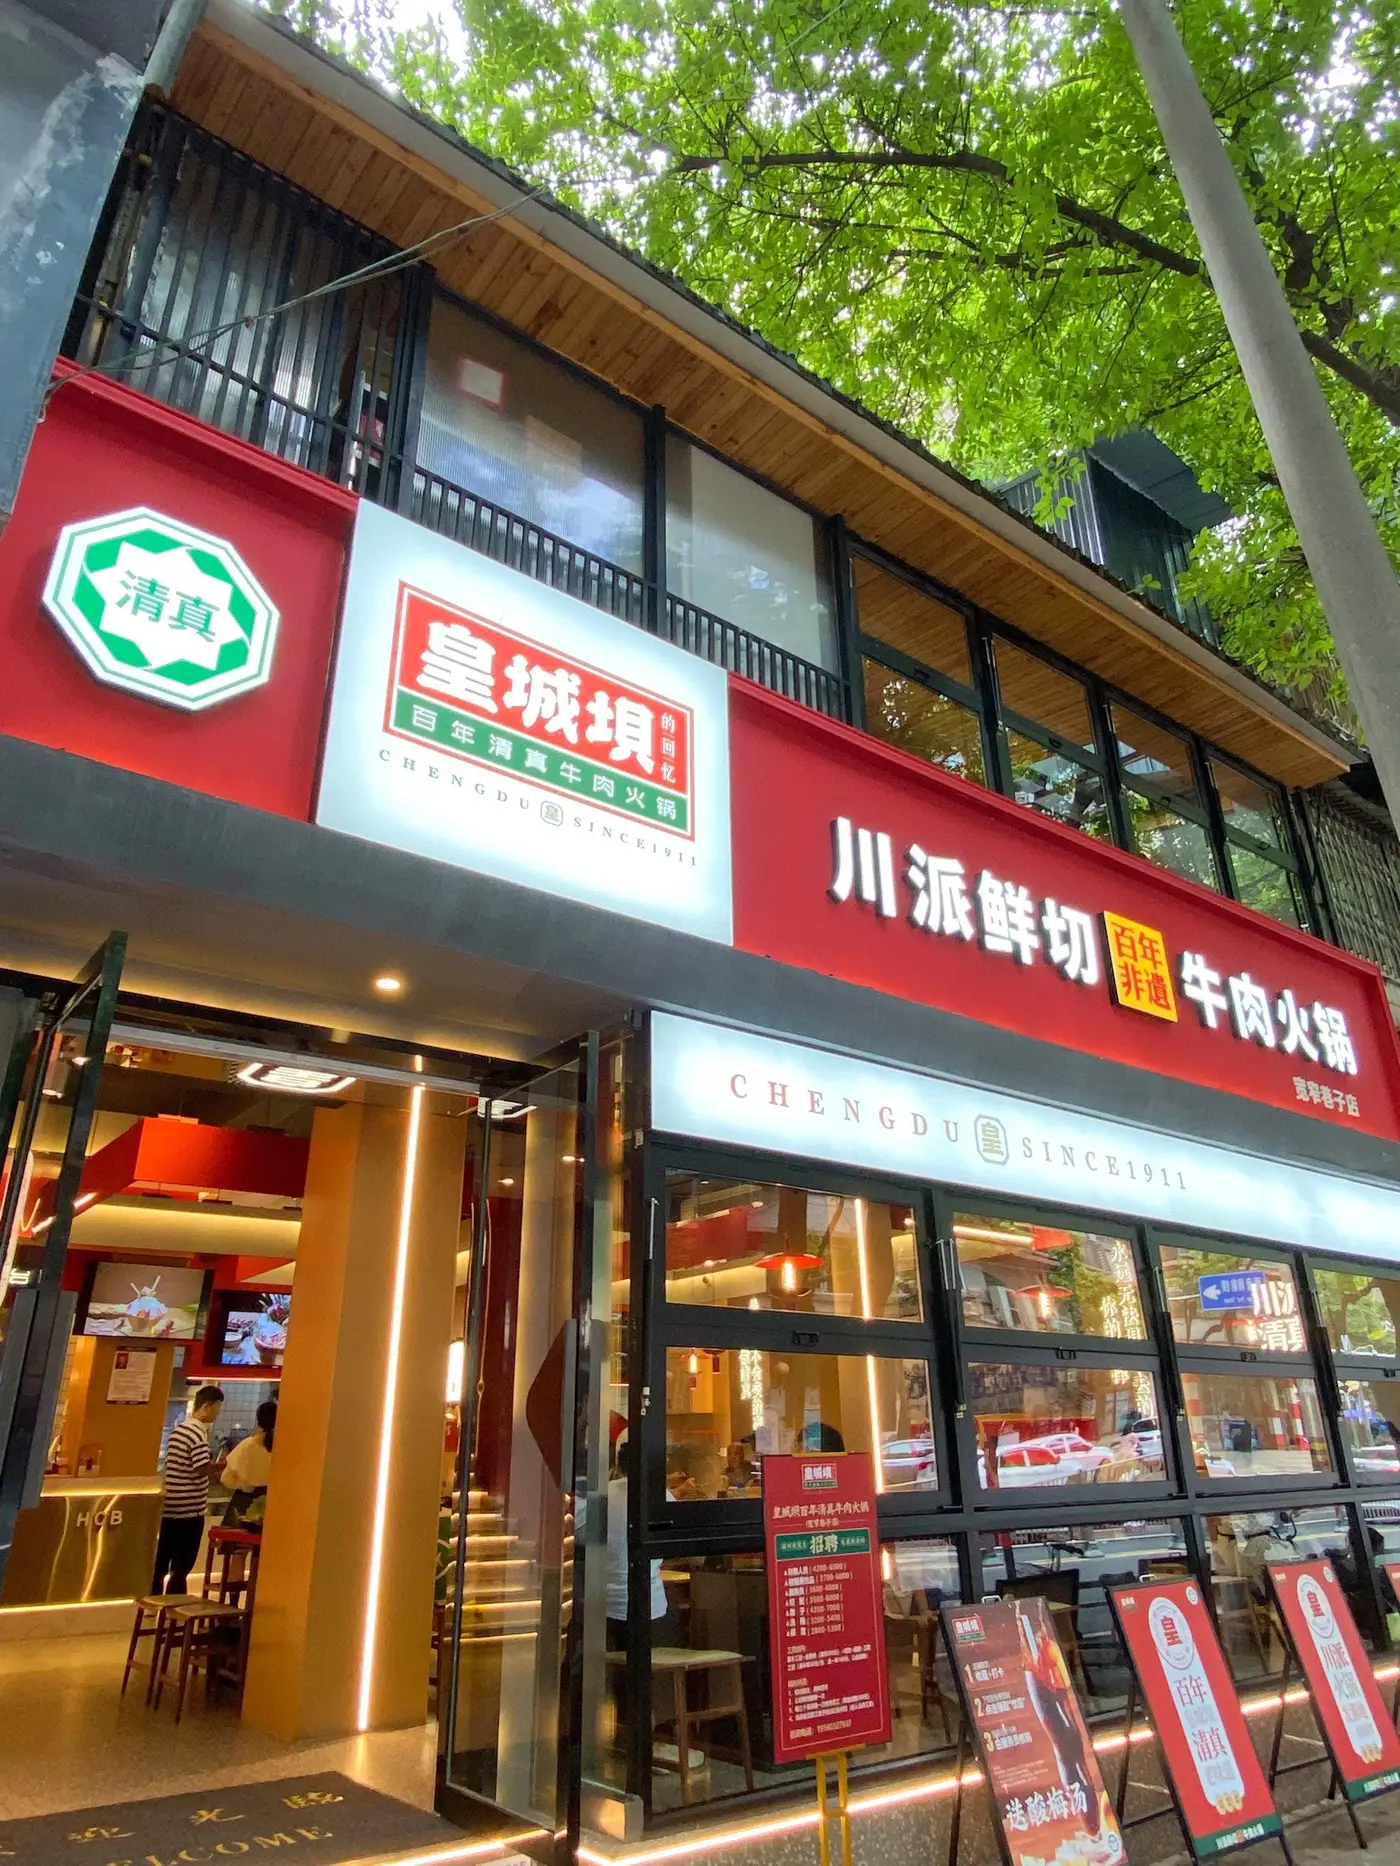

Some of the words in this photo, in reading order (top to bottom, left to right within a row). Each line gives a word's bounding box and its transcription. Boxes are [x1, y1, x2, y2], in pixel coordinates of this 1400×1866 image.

[116, 569, 220, 643] 清真
[412, 704, 677, 821] 百年清真牛肉火锅
[660, 711, 676, 785] 的回忆
[379, 748, 530, 811] CHENGDU
[573, 816, 697, 867] SINCE1911
[830, 816, 1099, 986] 川派鲜切
[1182, 951, 1358, 1076] 牛肉火锅
[1110, 921, 1163, 971] 百年
[729, 1073, 959, 1144] CHENGDU
[1292, 1076, 1360, 1117] 宽窄巷子店
[980, 1122, 1004, 1156] 皇
[1022, 1136, 1188, 1191] SINCE1911
[809, 1533, 839, 1555] 招聘
[1161, 1615, 1183, 1647] 皇
[1174, 1675, 1208, 1708] 百年
[1005, 1781, 1089, 1831] 送酸梅汤
